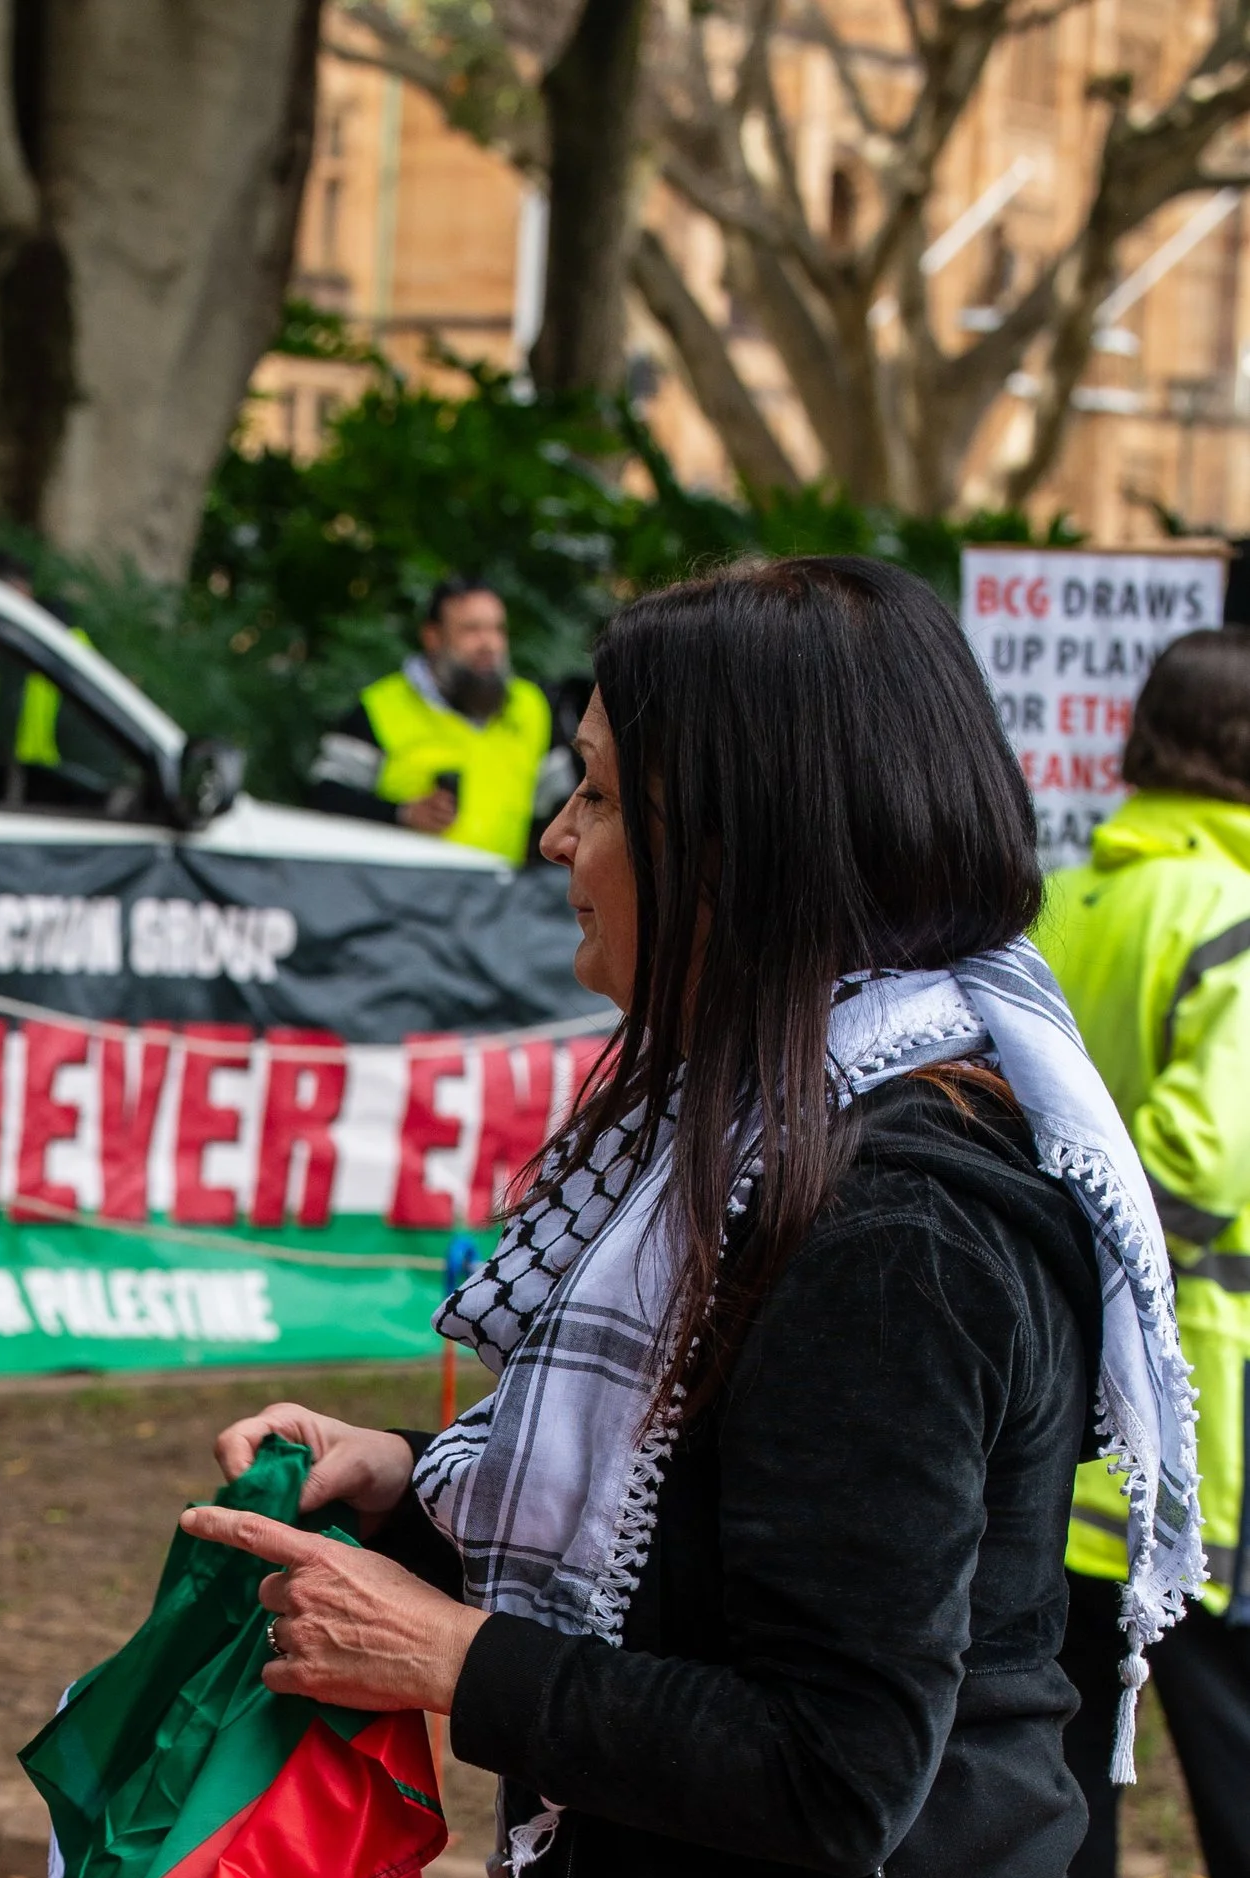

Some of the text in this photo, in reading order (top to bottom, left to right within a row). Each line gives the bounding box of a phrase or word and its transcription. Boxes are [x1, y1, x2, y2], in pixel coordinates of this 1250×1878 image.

[976, 576, 1204, 622] BCG DRAWS
[993, 634, 1156, 678] UP PLAN
[998, 692, 1132, 739] OR ETH
[130, 896, 297, 983] GROUP
[21, 1266, 281, 1344] PALESTINE
